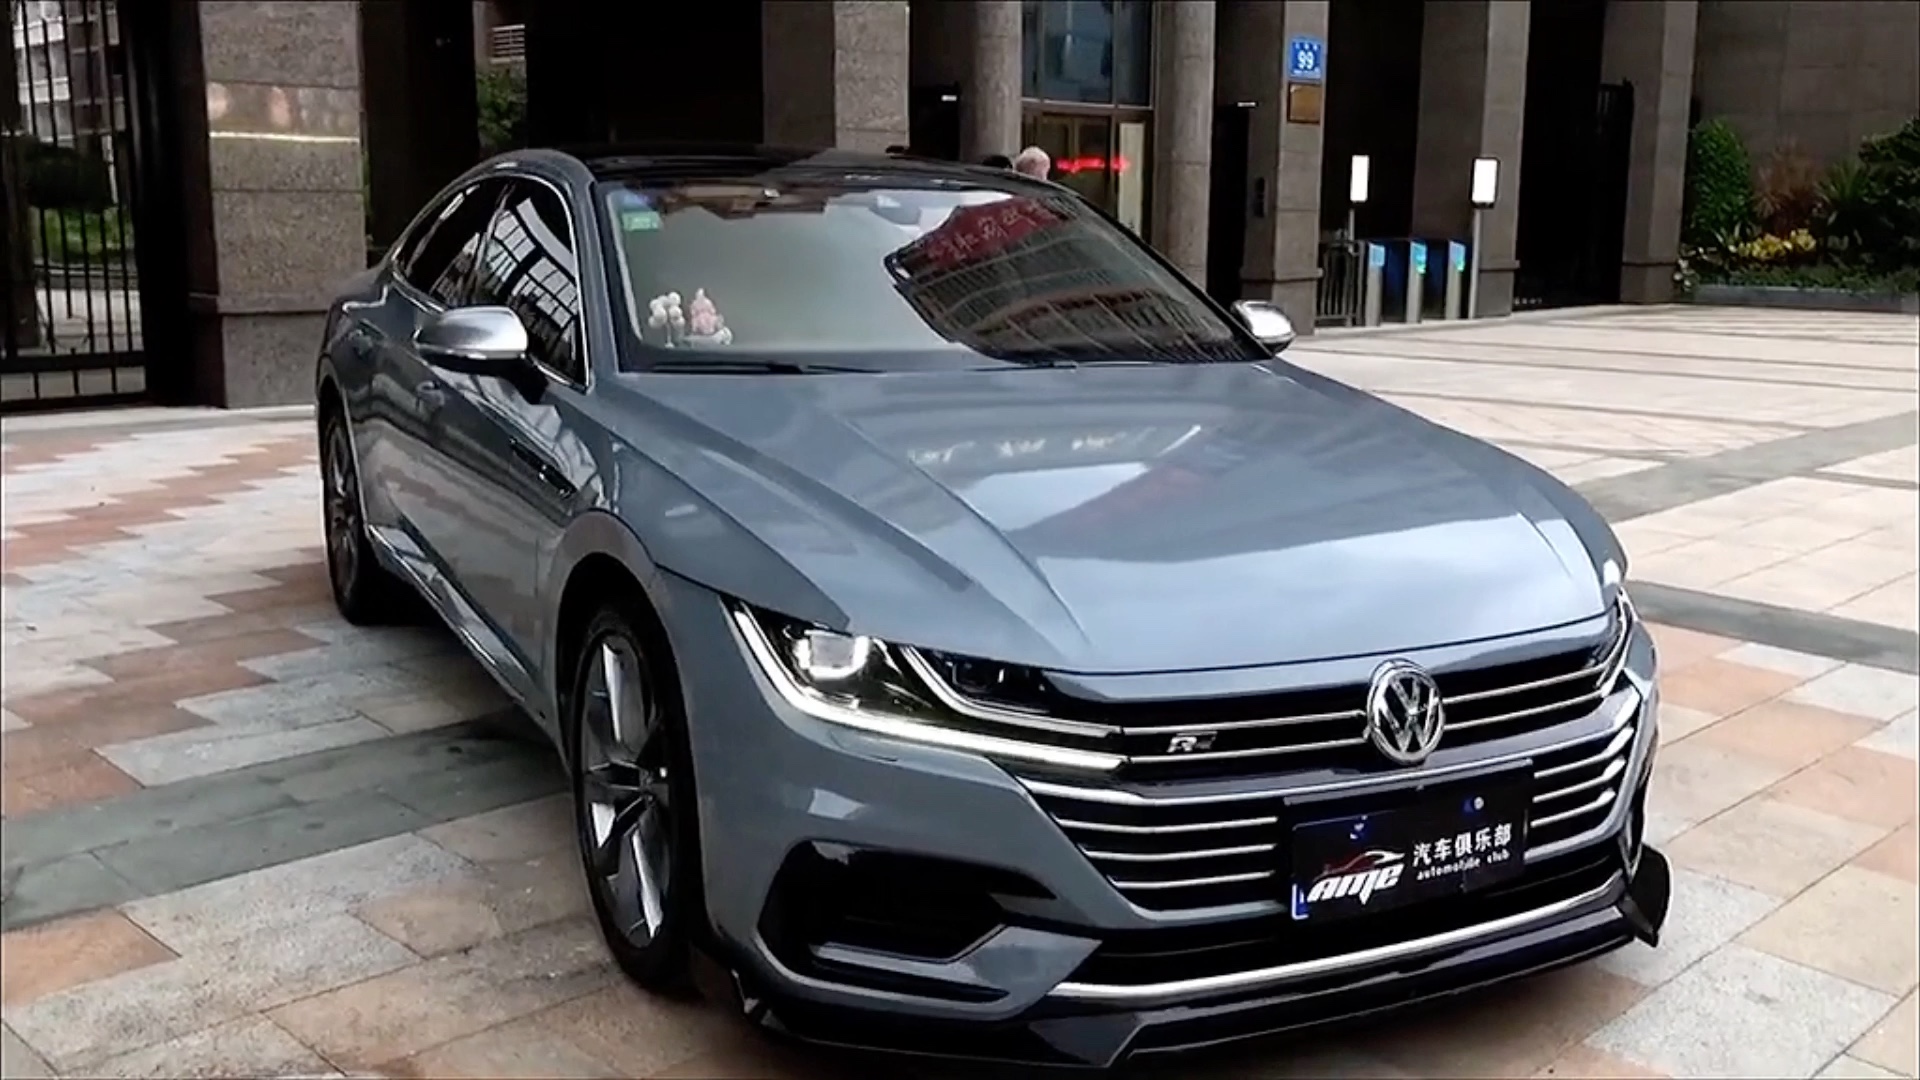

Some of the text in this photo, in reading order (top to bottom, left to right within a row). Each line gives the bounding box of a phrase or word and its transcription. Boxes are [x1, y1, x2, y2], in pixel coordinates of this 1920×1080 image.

[1297, 49, 1315, 70] 99
[1413, 823, 1512, 868] 汽车俱乐部
[1416, 849, 1509, 881] automobile club
